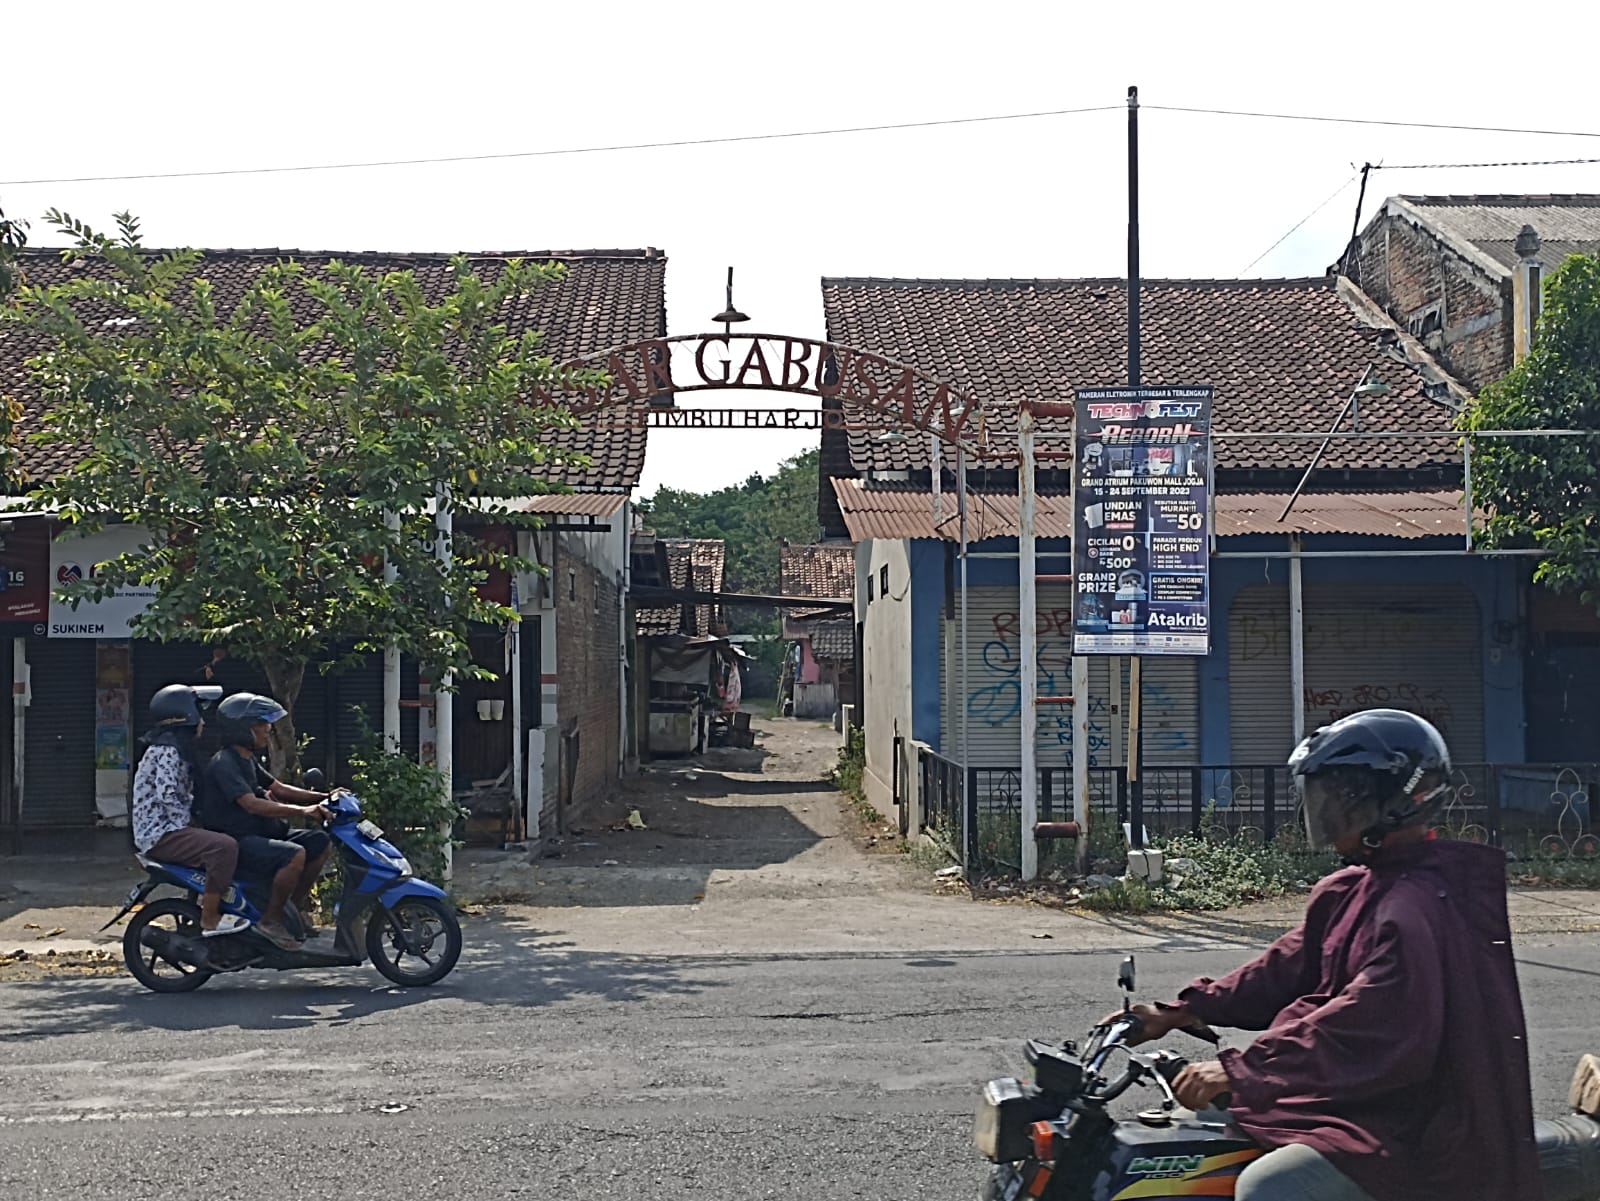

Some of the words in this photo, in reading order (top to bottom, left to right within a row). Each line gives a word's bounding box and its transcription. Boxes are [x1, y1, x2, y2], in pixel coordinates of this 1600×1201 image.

[694, 337, 978, 442] GABUSAN
[1081, 479, 1103, 487] GRAND
[1104, 478, 1129, 486] ATRIUM
[1130, 478, 1163, 486] PAKUWON
[1164, 477, 1182, 486] MALL
[1121, 487, 1168, 495] SEPTEMBER
[1104, 501, 1142, 510] UNDIAN
[1105, 511, 1137, 521] EMAS
[1087, 538, 1121, 546] CICILAN
[1152, 543, 1178, 552] HIGH
[1179, 543, 1200, 552] END
[1106, 557, 1131, 569] 500
[8, 571, 25, 582] 16
[1078, 572, 1117, 582] GRAND
[1078, 582, 1116, 593] PRIZE
[1147, 612, 1207, 626] Atakrib
[52, 624, 104, 634] SUKINEM
[1126, 1155, 1205, 1174] WIN
